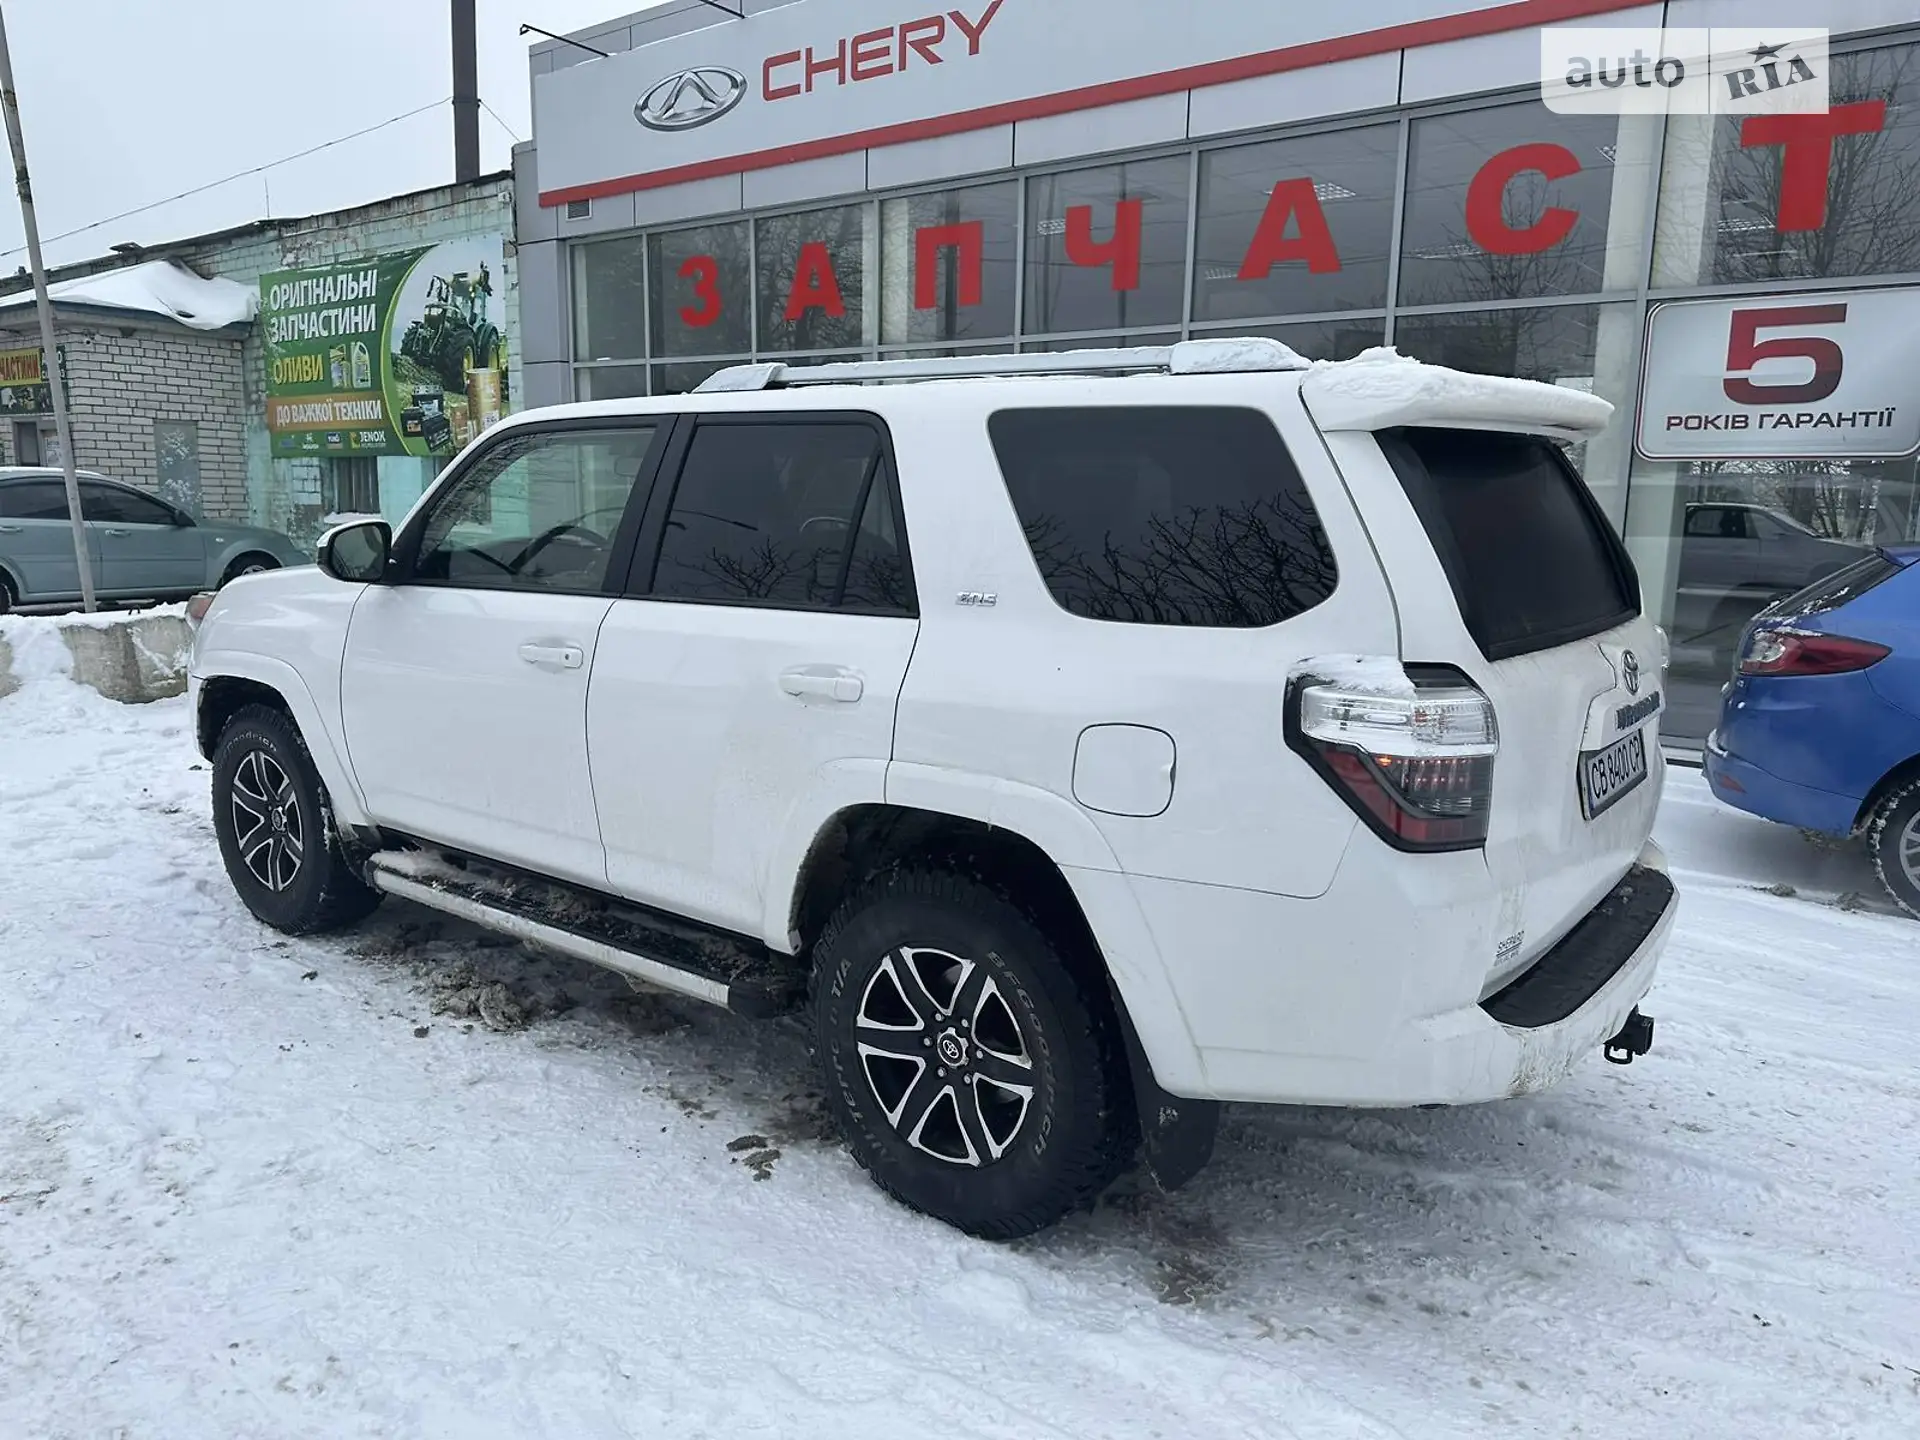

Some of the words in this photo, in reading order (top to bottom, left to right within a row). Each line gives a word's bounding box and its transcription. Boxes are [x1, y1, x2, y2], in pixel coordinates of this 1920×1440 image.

[762, 0, 1000, 101] CHERY
[270, 269, 377, 312] ОРИГІНАЛЬНІ
[270, 304, 377, 343] ЗАПЧАСТИНИ
[274, 354, 324, 385] ОЛИВИ
[1723, 303, 1848, 405] 5
[276, 405, 291, 427] ДО
[291, 398, 333, 423] ВАЖКОЇ
[333, 400, 382, 421] ТЕХНІКИ
[1666, 414, 1749, 431] РОКІВ
[1758, 407, 1896, 430] ГАРАНТІЇ
